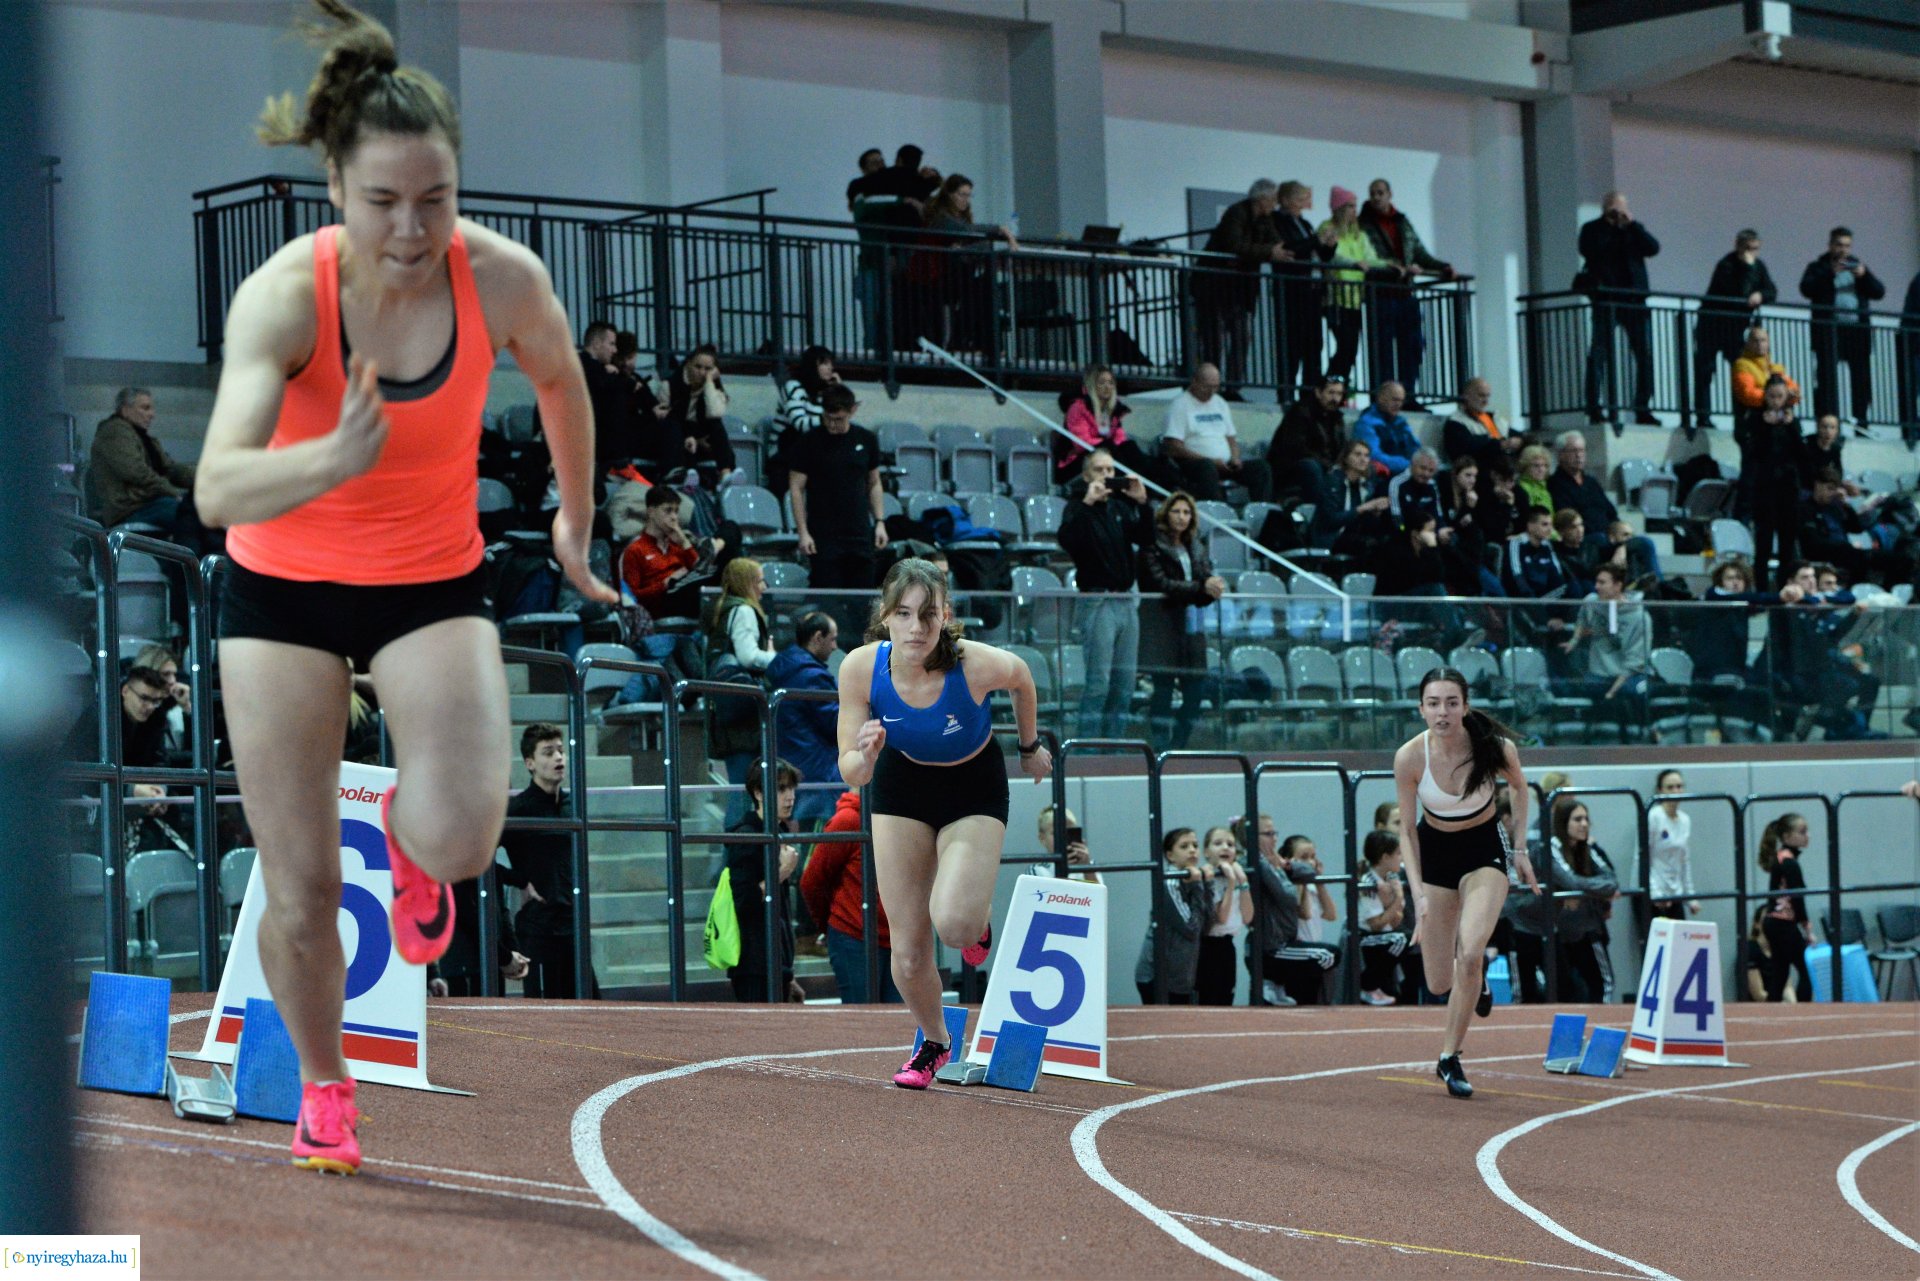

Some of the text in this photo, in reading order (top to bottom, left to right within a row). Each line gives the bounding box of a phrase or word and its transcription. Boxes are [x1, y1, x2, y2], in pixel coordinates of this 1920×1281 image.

[1047, 894, 1092, 907] polanik
[1009, 911, 1090, 1027] 5
[1641, 944, 1664, 1028] 4
[1673, 947, 1714, 1031] 4
